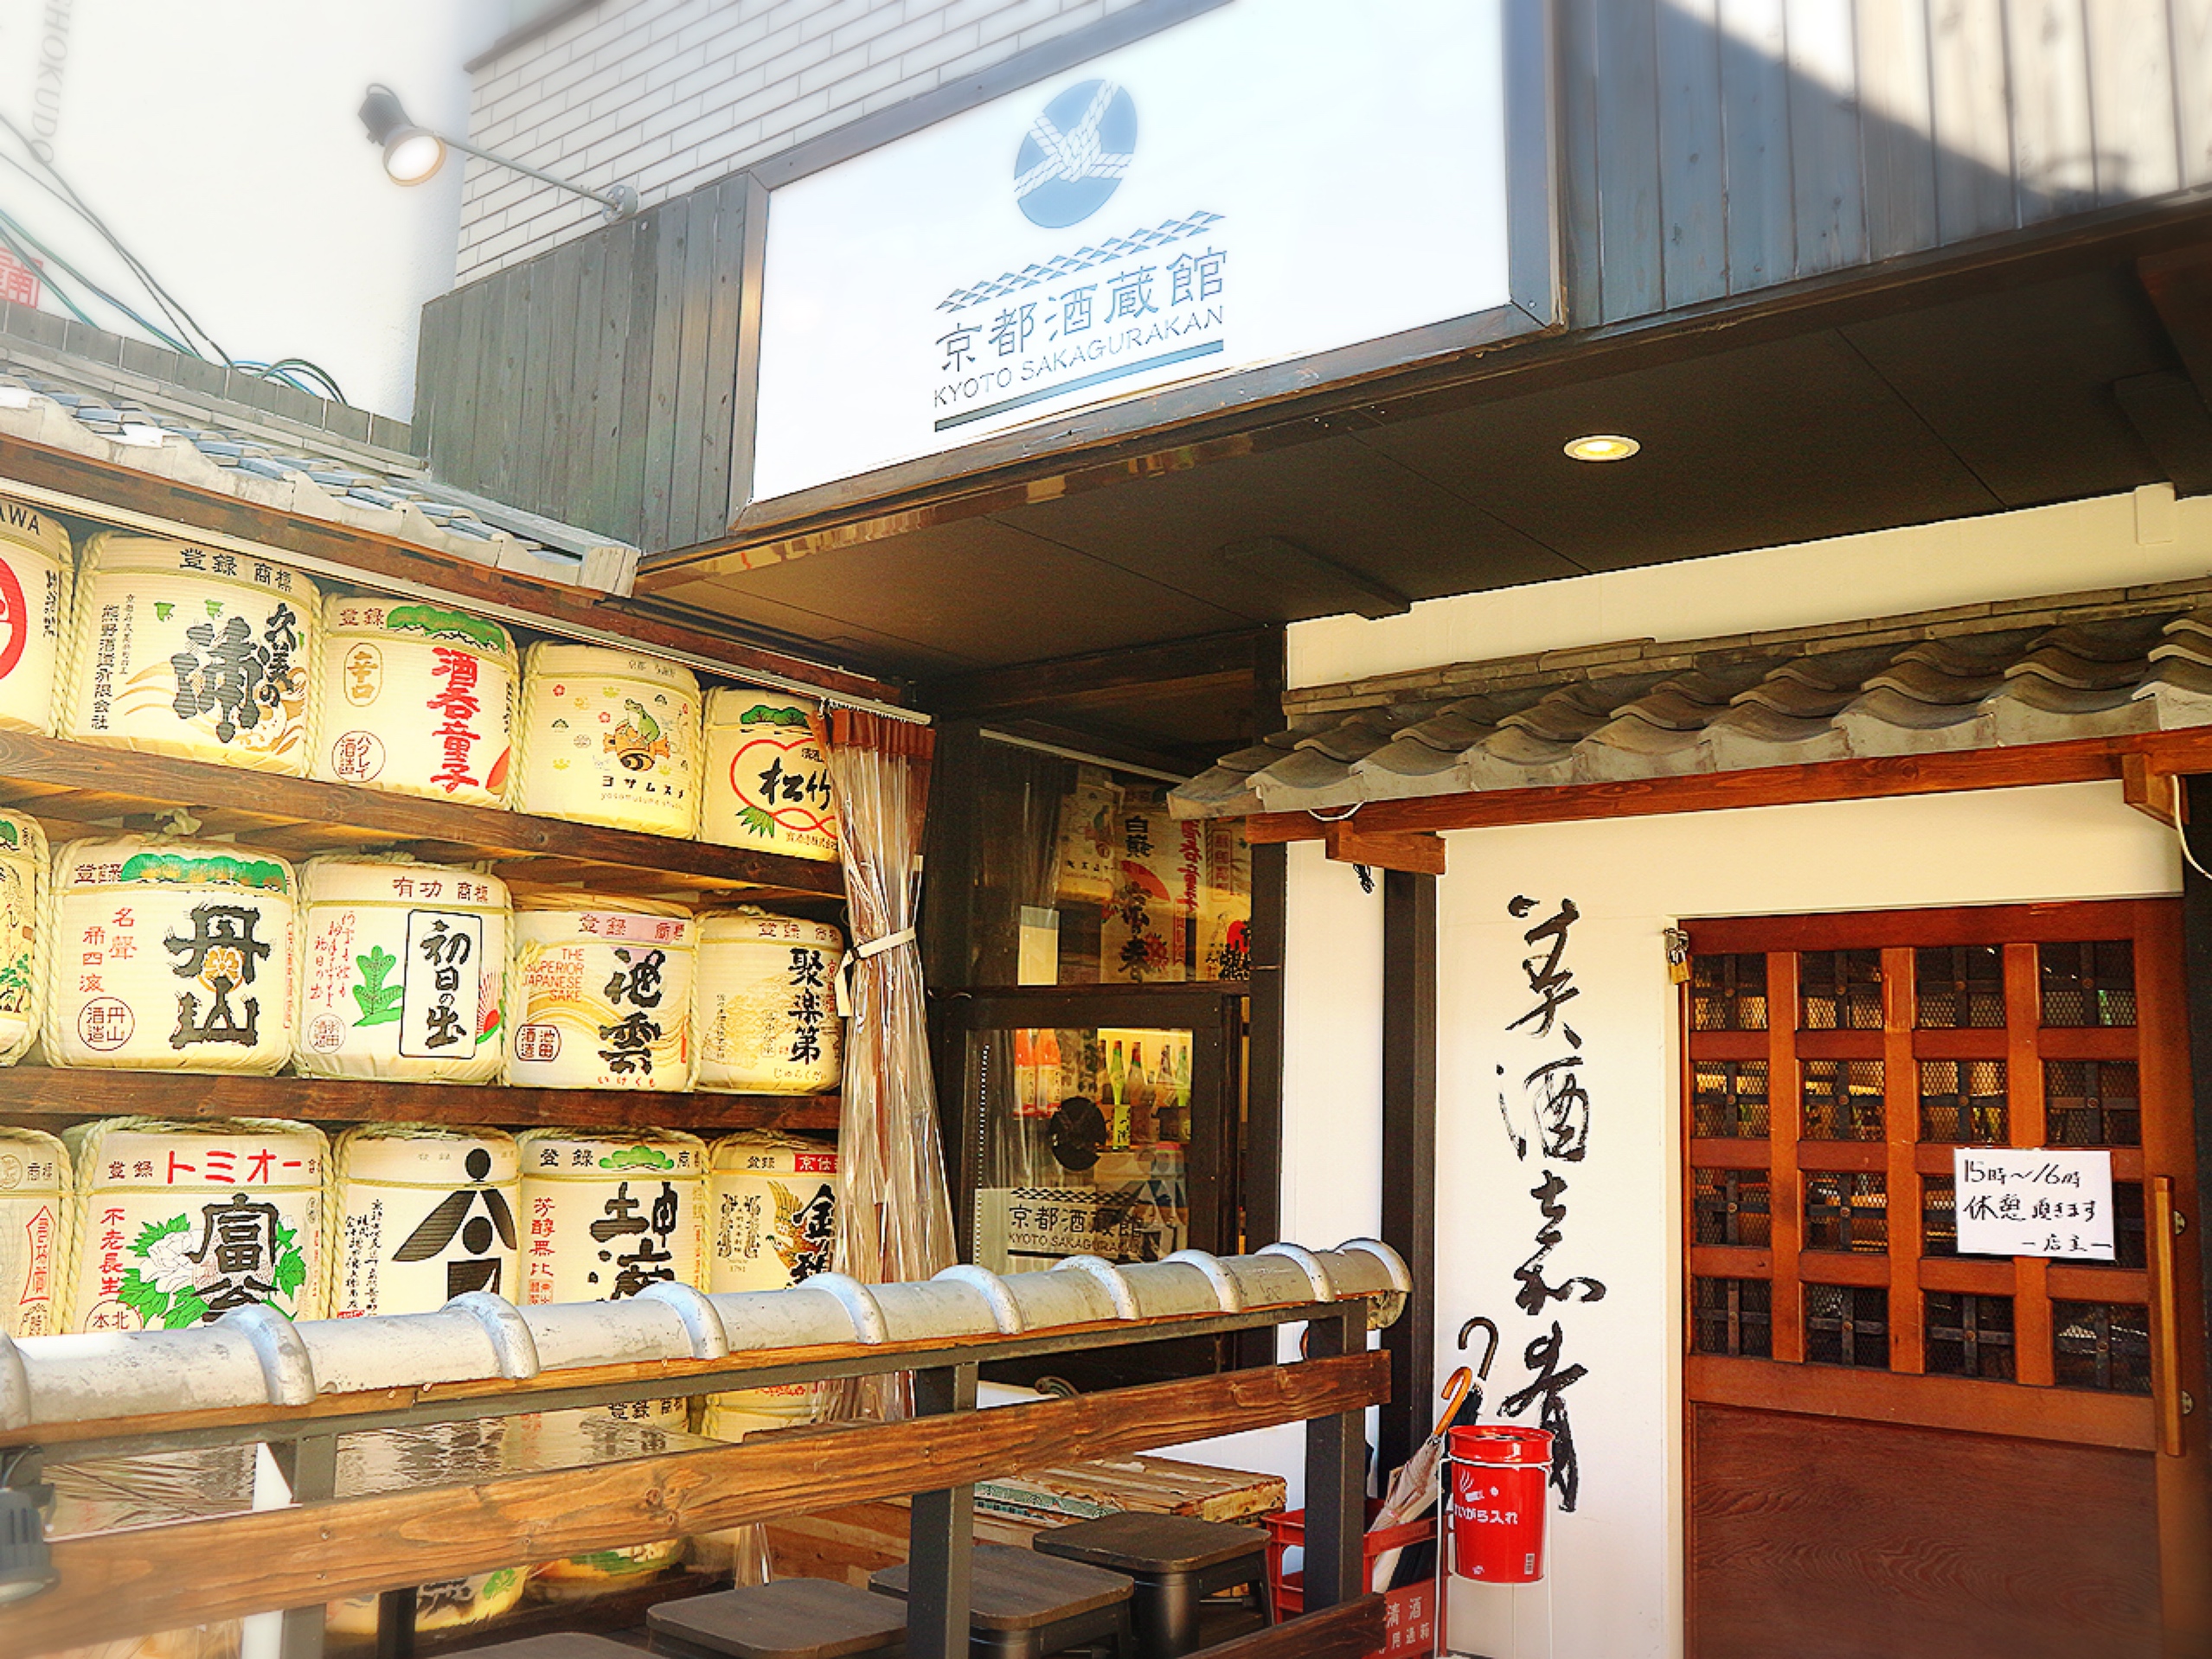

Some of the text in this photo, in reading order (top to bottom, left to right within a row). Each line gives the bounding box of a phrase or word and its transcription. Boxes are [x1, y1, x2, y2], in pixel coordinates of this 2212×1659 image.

[30, 0, 72, 164] HOKUDO
[935, 246, 1227, 372] 京都酒蔵館
[934, 305, 1223, 408] KYOTO SAKAGURAKAN
[180, 548, 237, 576] 登録
[338, 608, 384, 627] 登録
[347, 651, 379, 699] 辛口
[426, 646, 481, 793] 酒呑童子
[602, 775, 684, 799] ヨサムスメ
[758, 757, 831, 811] 松竹
[392, 876, 443, 898] 有功
[579, 913, 626, 936] 登録
[758, 922, 801, 939] 登録
[524, 960, 585, 975] SUPERIOR
[561, 948, 585, 962] THE
[163, 904, 271, 1050] 丹山
[420, 919, 472, 1050] 初日の出
[522, 972, 582, 990] JAPANESE
[549, 990, 582, 1002] SAKE
[597, 948, 666, 1075] 池雲
[787, 948, 824, 1066] 聚楽第
[87, 1006, 105, 1043] 酒造
[106, 1006, 126, 1042] 丹山
[167, 1149, 303, 1184] トミオー
[540, 1148, 594, 1168] 登録
[798, 1155, 837, 1171] 京仕
[98, 1207, 126, 1297] 不老長生
[528, 1196, 555, 1278] 芳醇無比
[1008, 1233, 1048, 1246] KYOTO
[1453, 1502, 1518, 1526] いがら入れ
